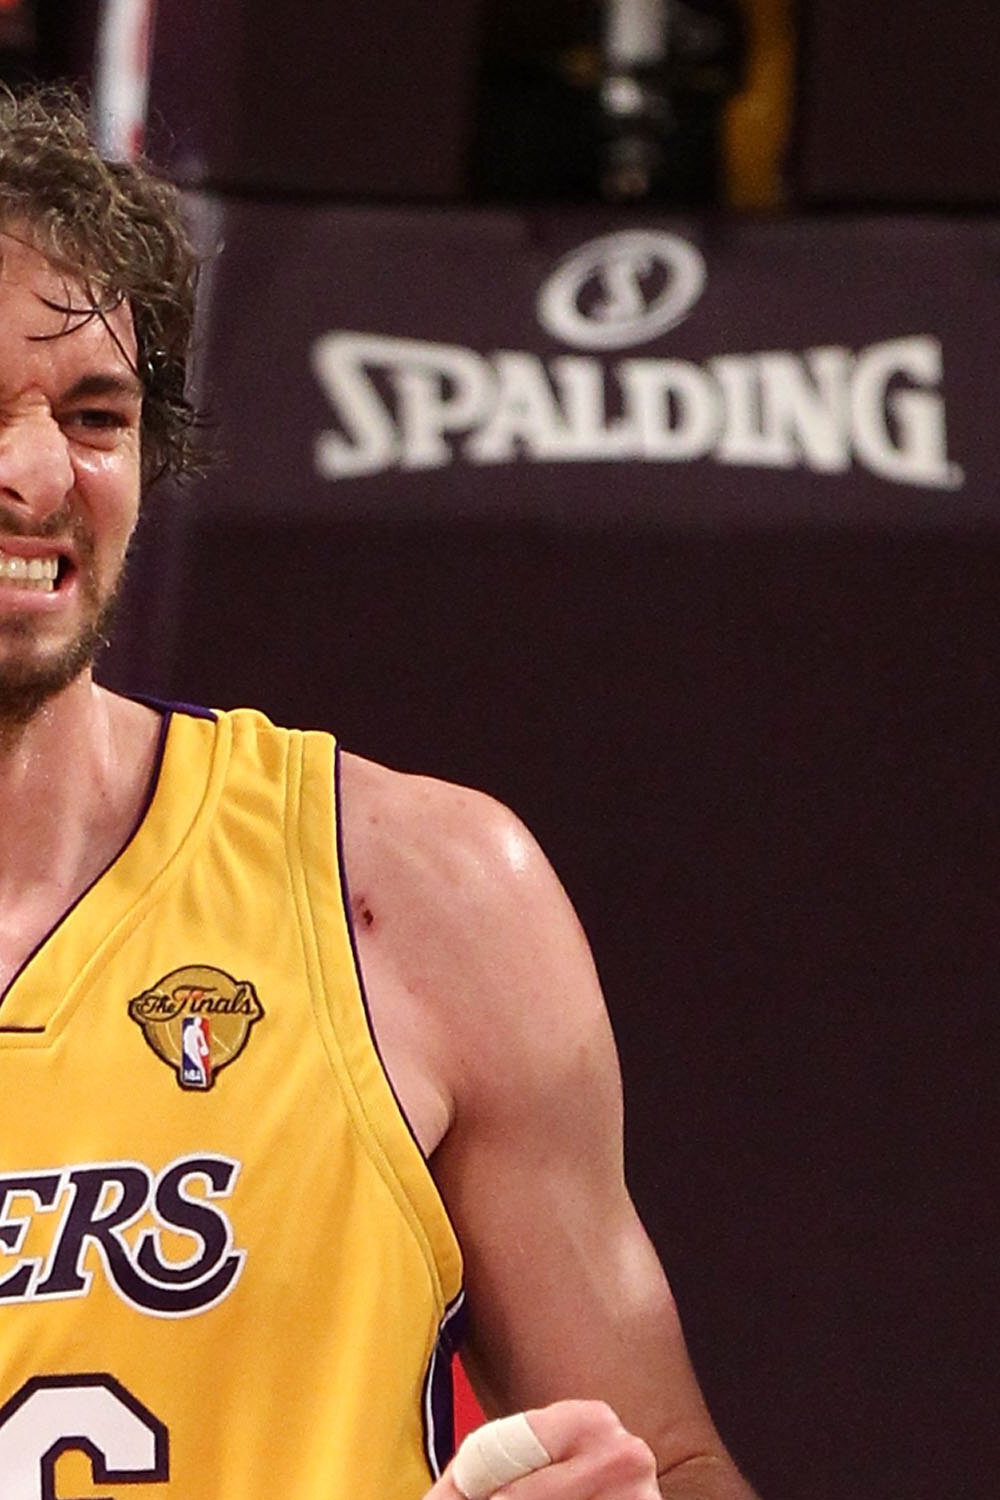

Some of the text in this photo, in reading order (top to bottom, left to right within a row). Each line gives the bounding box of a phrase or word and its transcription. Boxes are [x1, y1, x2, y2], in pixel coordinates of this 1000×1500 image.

[312, 330, 963, 488] SPALDING
[136, 984, 256, 1020] The Finals
